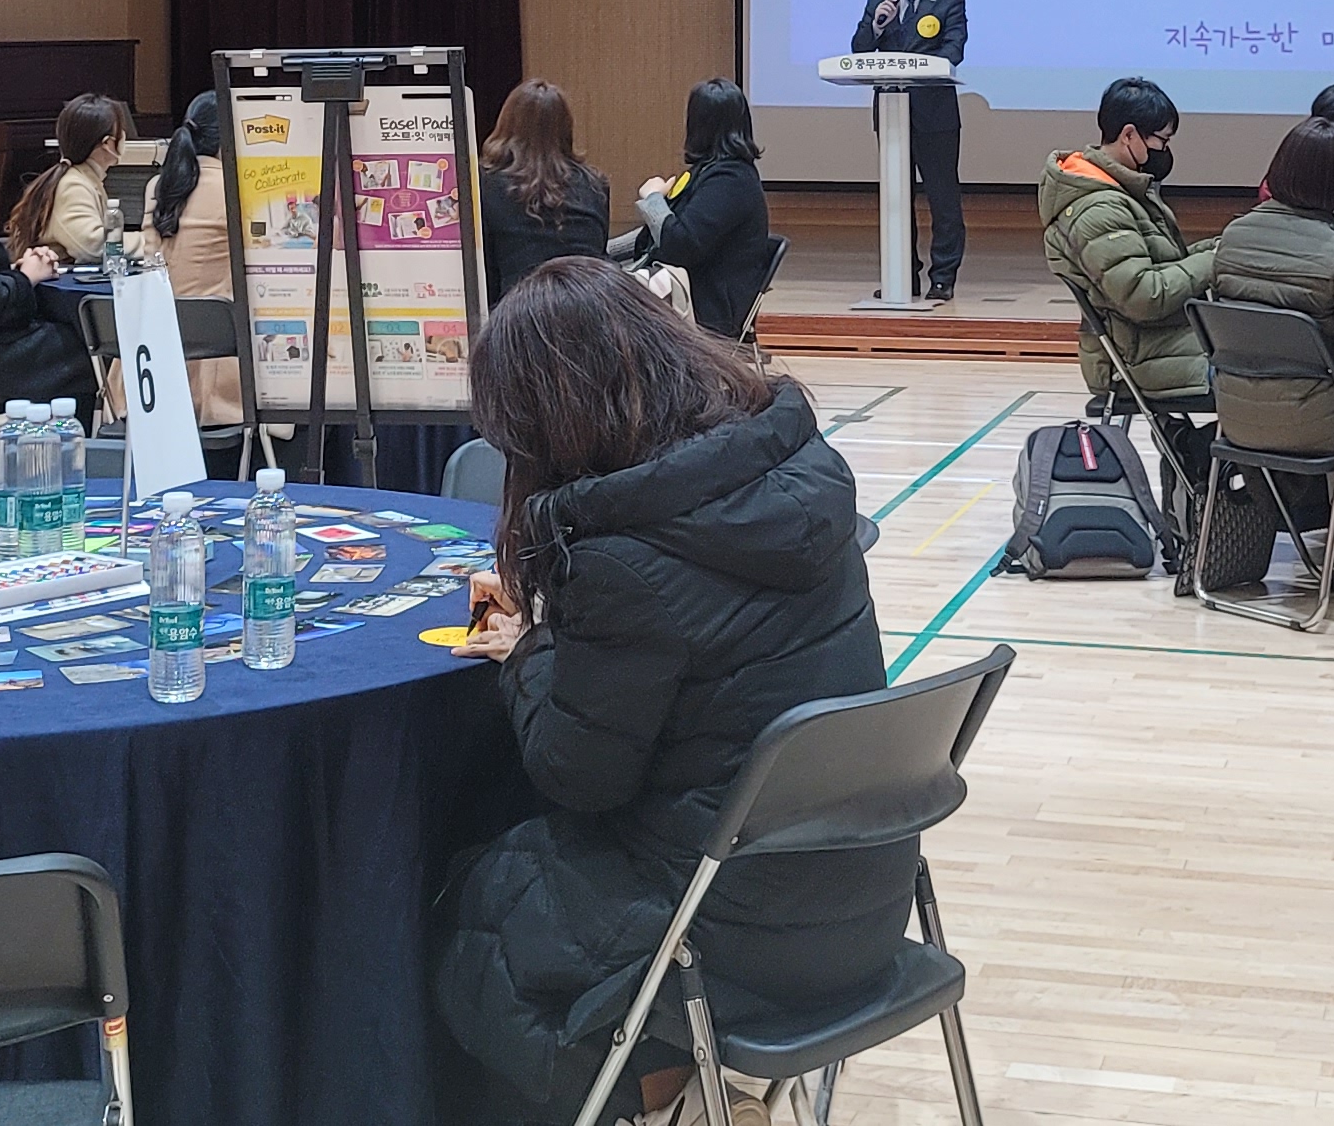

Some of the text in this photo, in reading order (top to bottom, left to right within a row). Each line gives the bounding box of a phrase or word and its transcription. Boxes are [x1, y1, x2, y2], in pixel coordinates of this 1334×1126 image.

[1164, 20, 1299, 55] 지속가능한
[379, 115, 419, 130] Easel
[135, 343, 156, 414] 6
